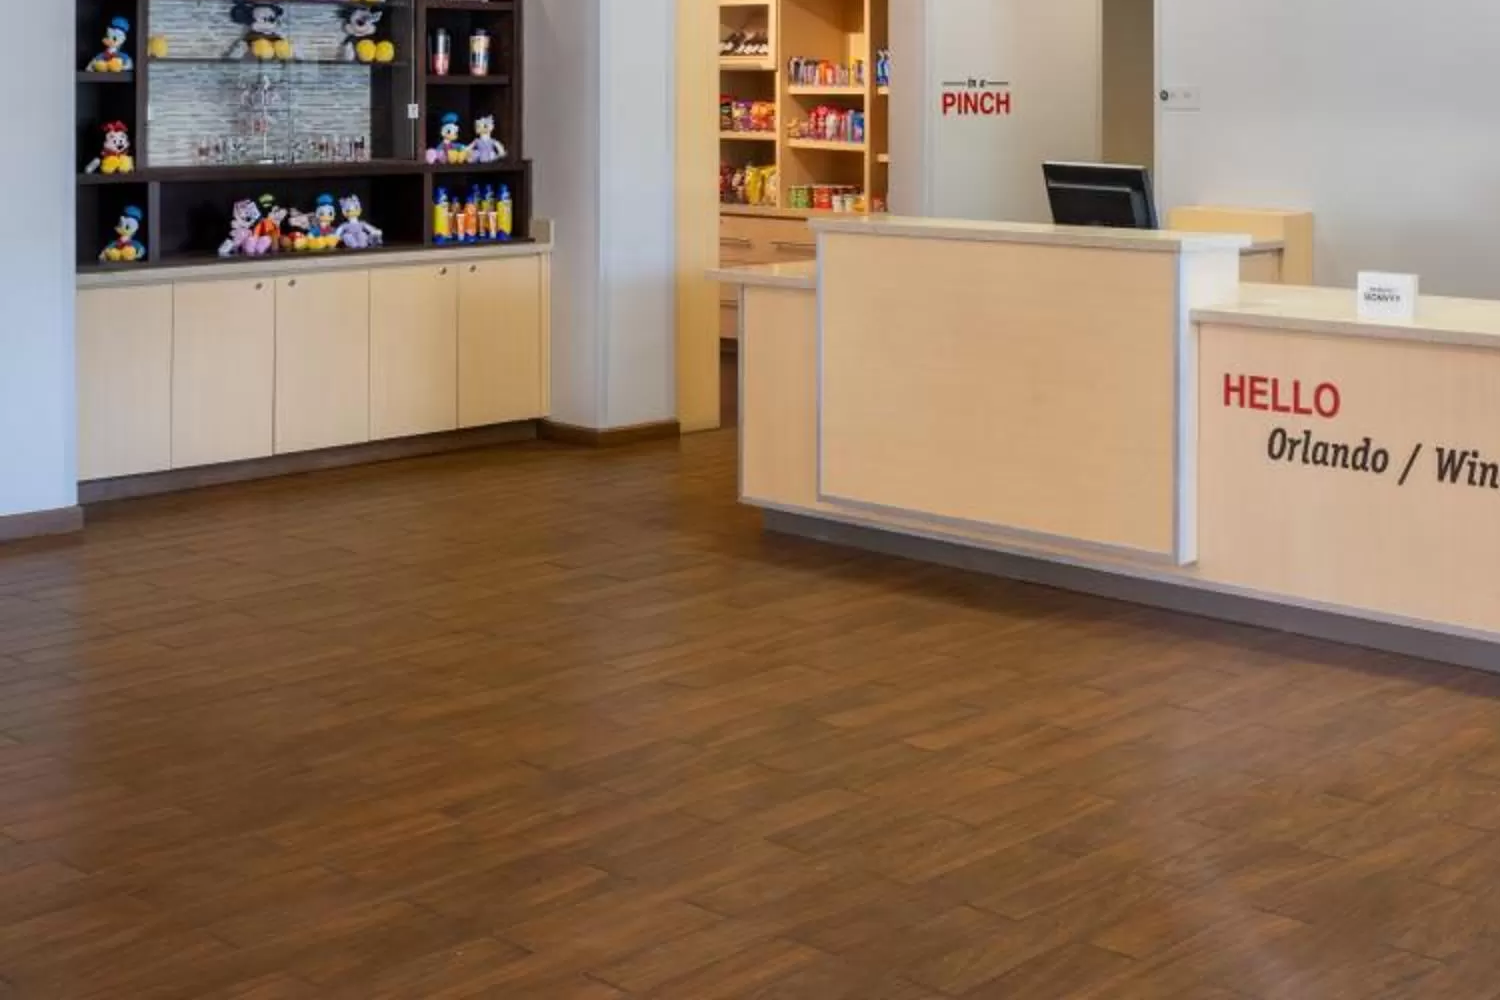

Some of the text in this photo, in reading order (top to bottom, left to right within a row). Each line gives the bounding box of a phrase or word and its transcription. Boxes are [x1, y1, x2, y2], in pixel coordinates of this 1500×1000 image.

[942, 91, 1010, 115] PINCH
[1223, 373, 1341, 418] HELLO
[1267, 427, 1389, 474] Orlando
[1397, 443, 1422, 486] /
